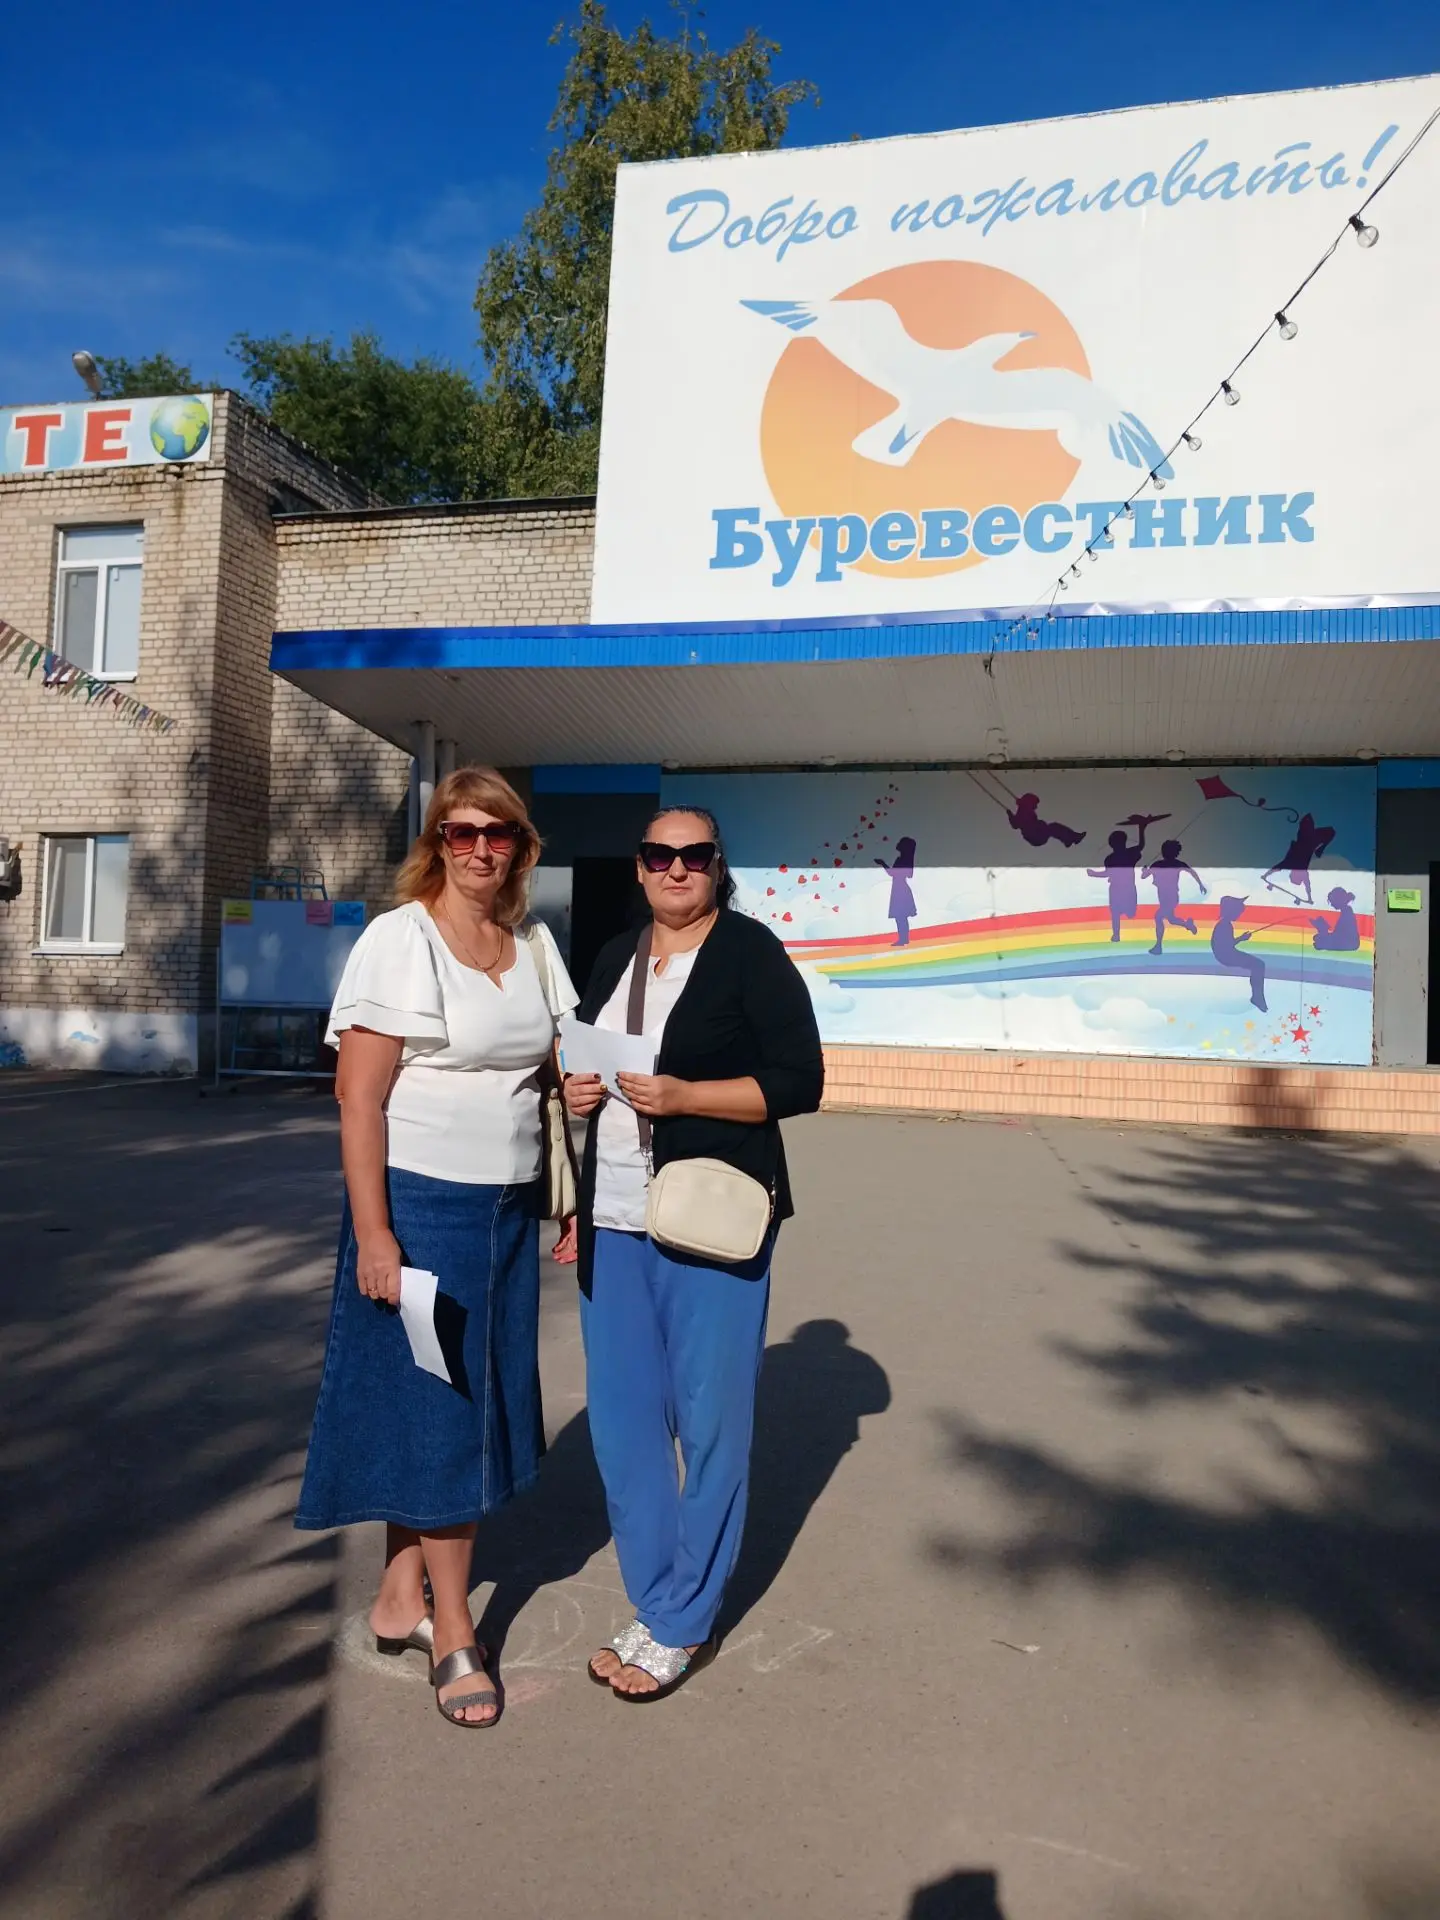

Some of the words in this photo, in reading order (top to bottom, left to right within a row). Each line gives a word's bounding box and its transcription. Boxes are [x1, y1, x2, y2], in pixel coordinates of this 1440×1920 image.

[666, 188, 858, 262] Добро
[891, 124, 1400, 237] пожаловать!
[708, 491, 1316, 588] Буревестник
